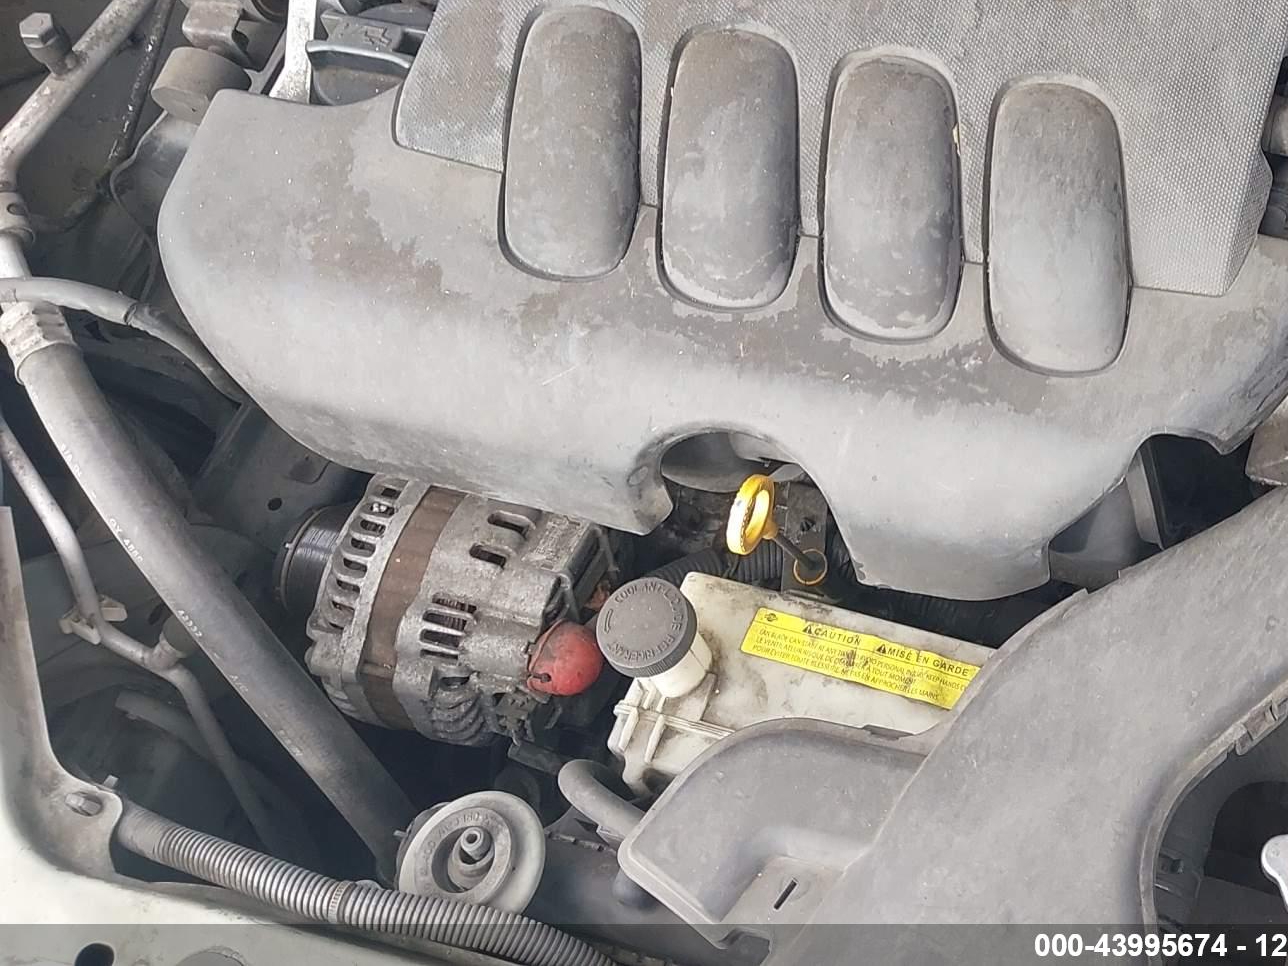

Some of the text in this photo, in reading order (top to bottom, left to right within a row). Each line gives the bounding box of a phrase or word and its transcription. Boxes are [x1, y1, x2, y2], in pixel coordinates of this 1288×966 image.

[813, 626, 861, 646] CAUTION
[755, 636, 763, 644] LE
[871, 667, 888, 677] TOUT
[888, 672, 916, 685] MOMENT
[788, 636, 801, 644] CAN
[825, 645, 837, 654] ANY
[876, 659, 905, 674] PERSONAL
[939, 678, 960, 690] HANDS
[931, 658, 969, 677] GARDE
[869, 675, 907, 692] APPROCHER
